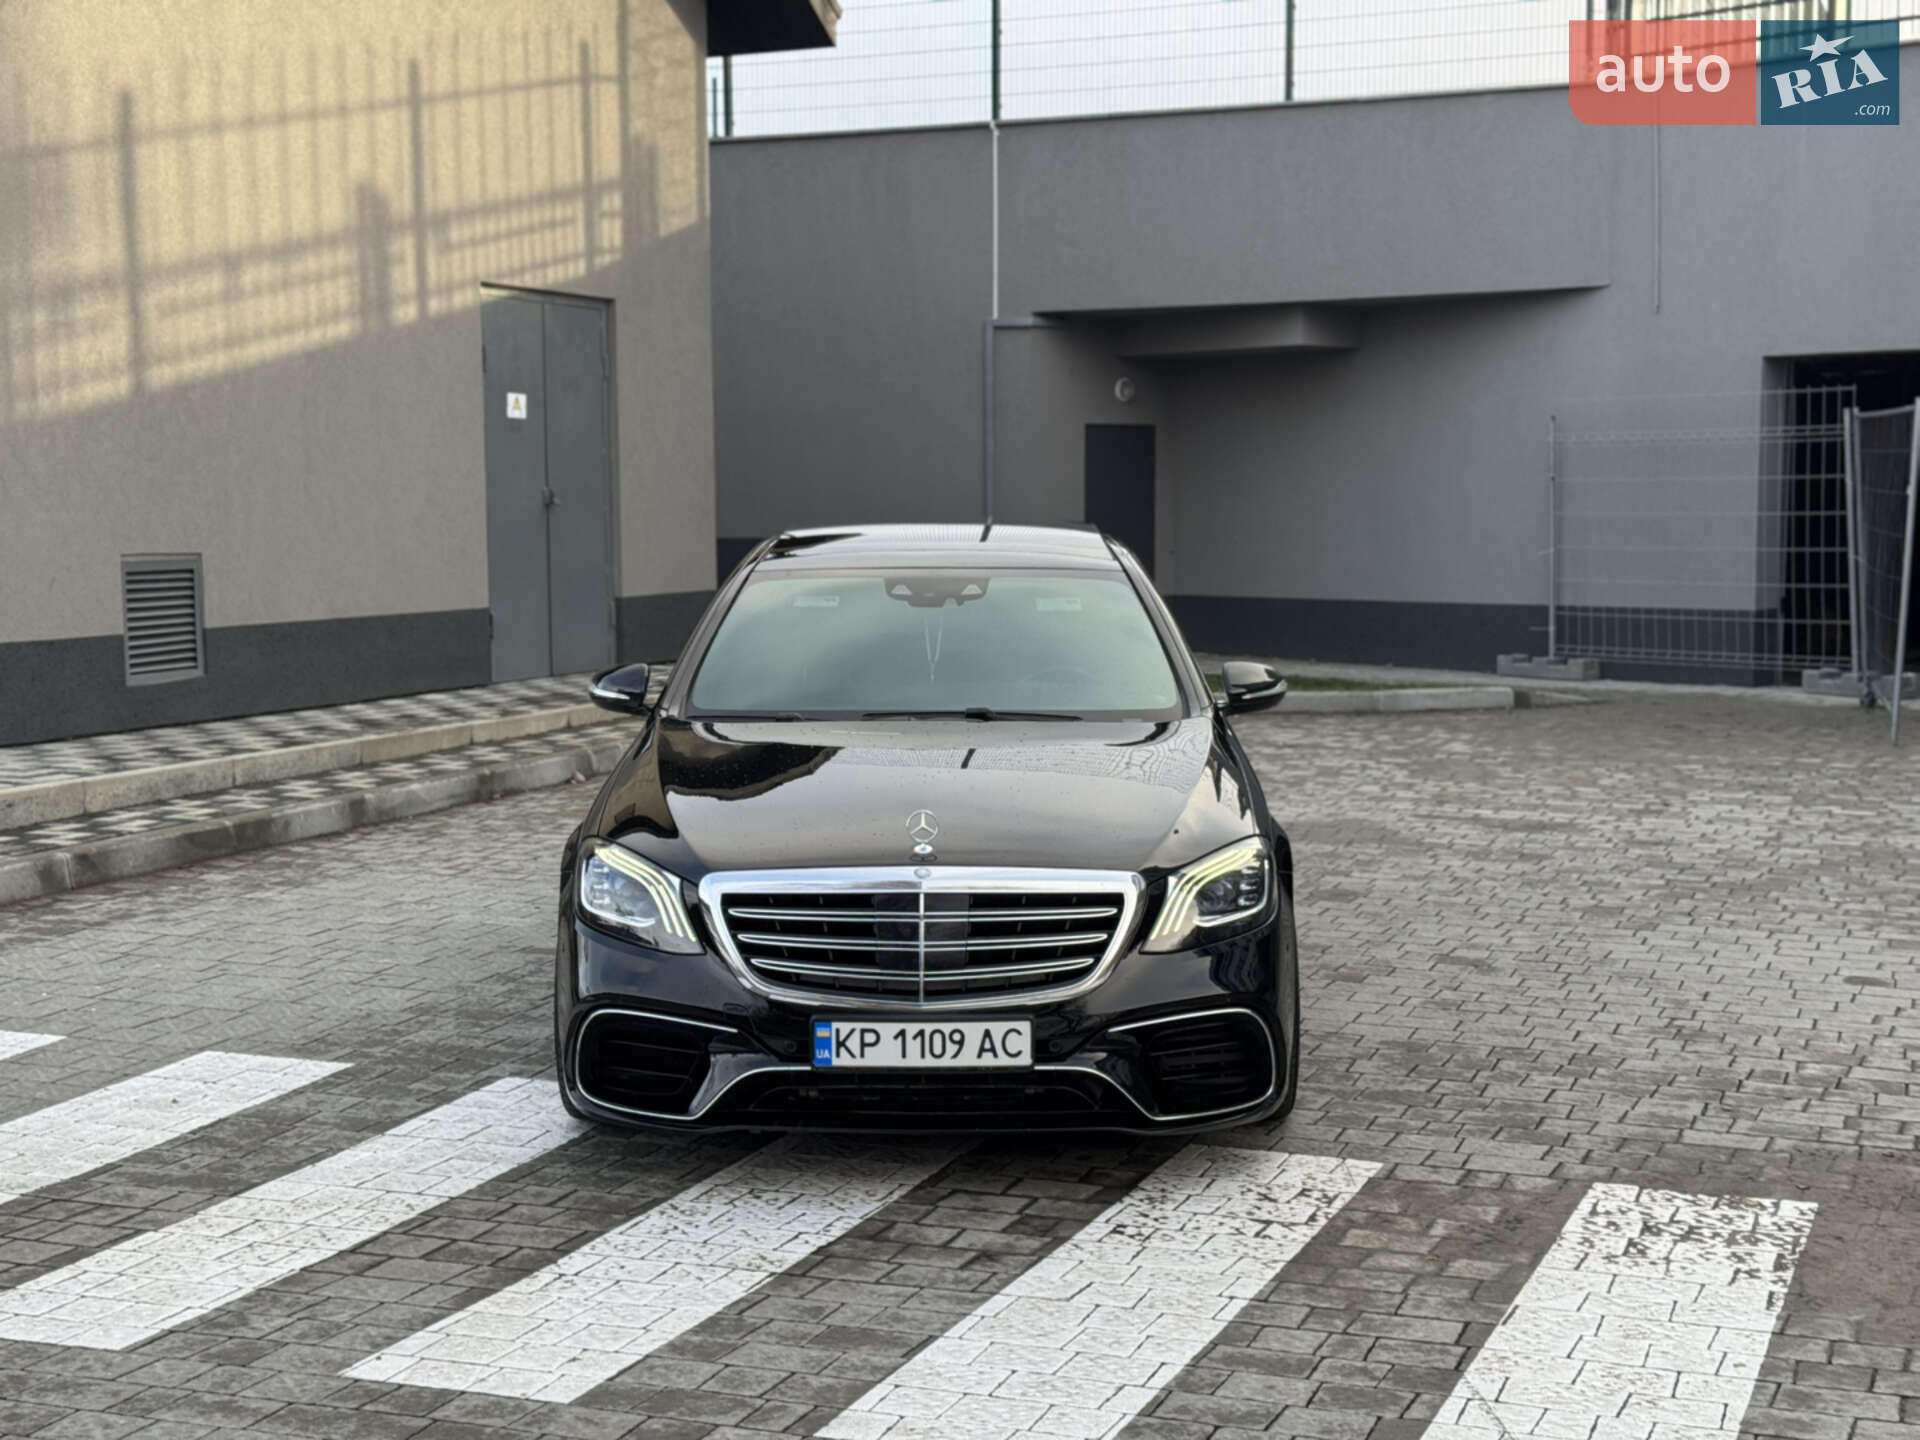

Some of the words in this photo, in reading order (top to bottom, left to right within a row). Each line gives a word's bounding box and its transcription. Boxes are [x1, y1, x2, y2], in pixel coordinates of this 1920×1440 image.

[835, 1028, 881, 1059] KP
[893, 1028, 966, 1059] 1109
[976, 1028, 1024, 1059] AC
[816, 1049, 831, 1059] UA
